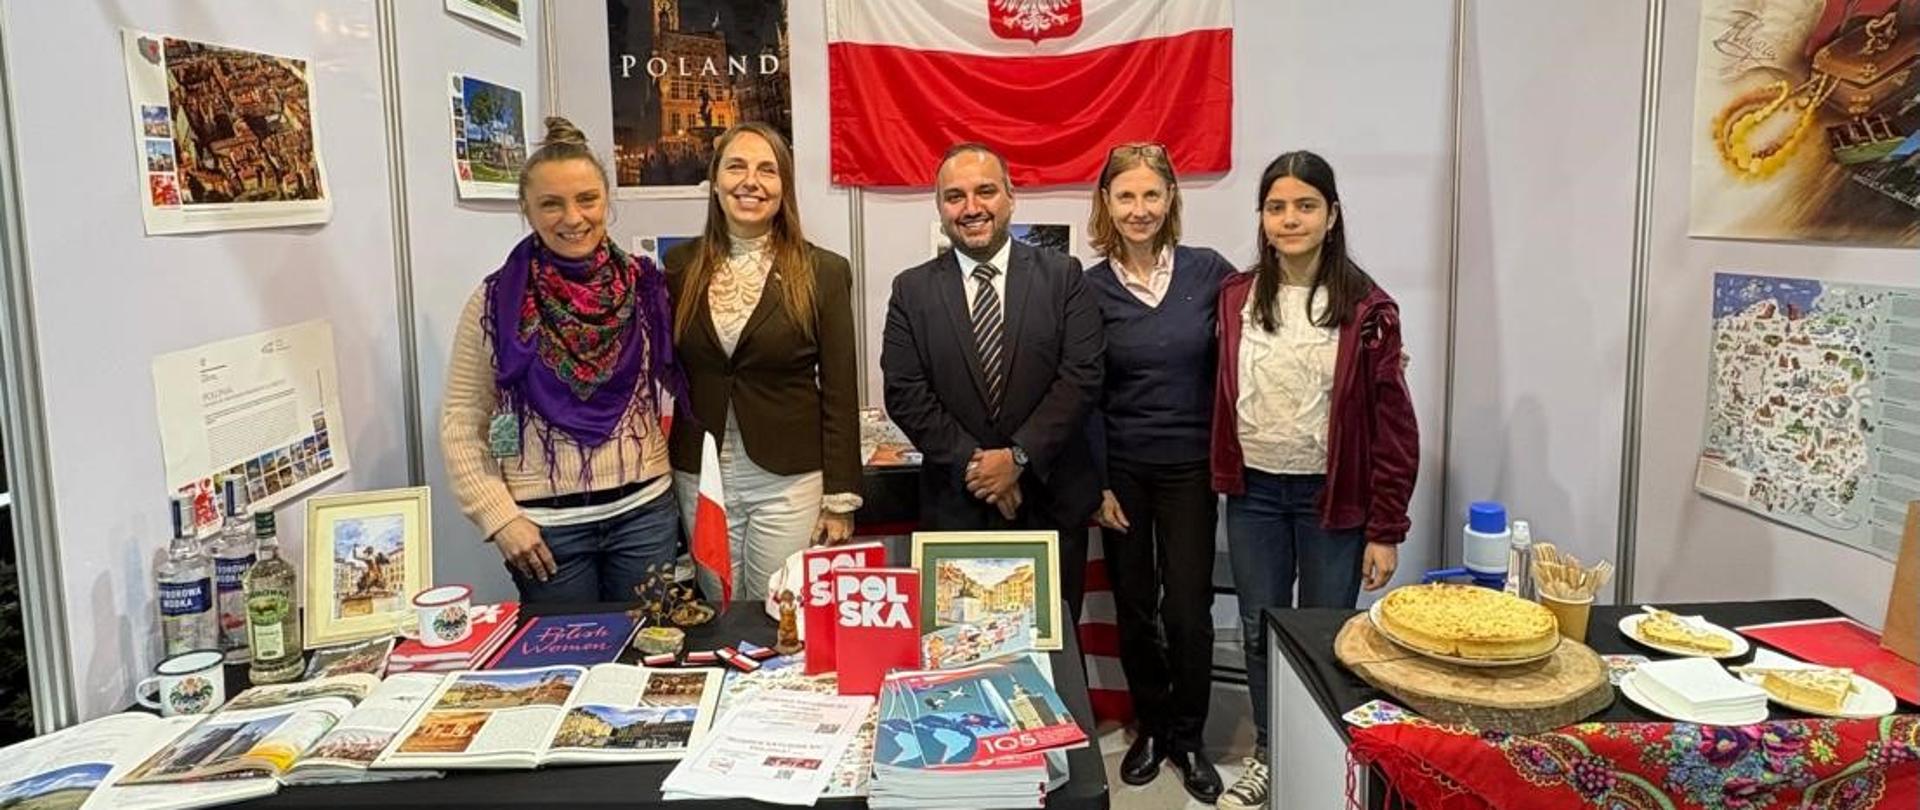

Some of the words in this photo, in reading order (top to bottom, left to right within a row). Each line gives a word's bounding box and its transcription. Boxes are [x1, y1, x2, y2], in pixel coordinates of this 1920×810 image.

[620, 54, 780, 78] POLAND
[837, 576, 909, 602] POL
[839, 601, 913, 629] SKA
[537, 625, 609, 642] Polish
[982, 733, 1037, 754] 105
